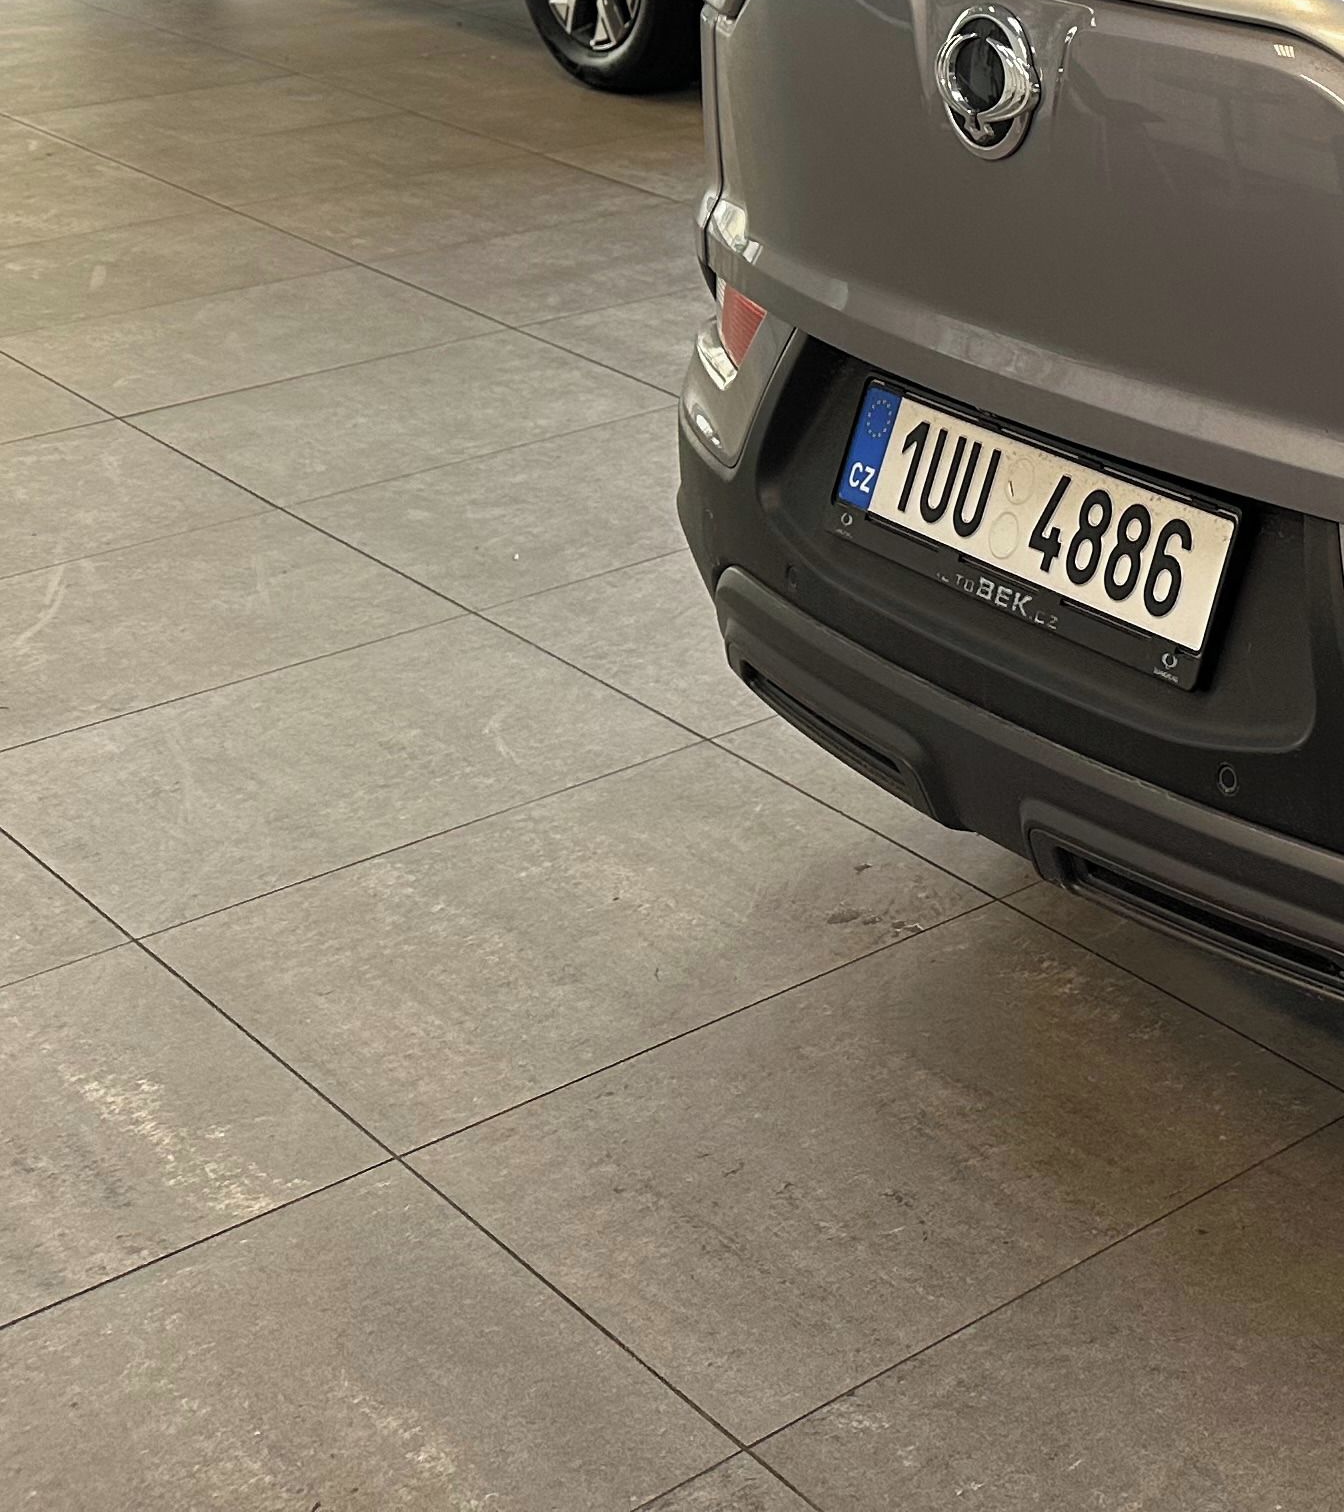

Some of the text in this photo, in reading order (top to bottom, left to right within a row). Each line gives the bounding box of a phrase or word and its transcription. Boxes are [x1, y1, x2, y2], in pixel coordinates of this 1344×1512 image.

[848, 461, 876, 494] CZ
[897, 420, 1193, 618] 1UU 4886
